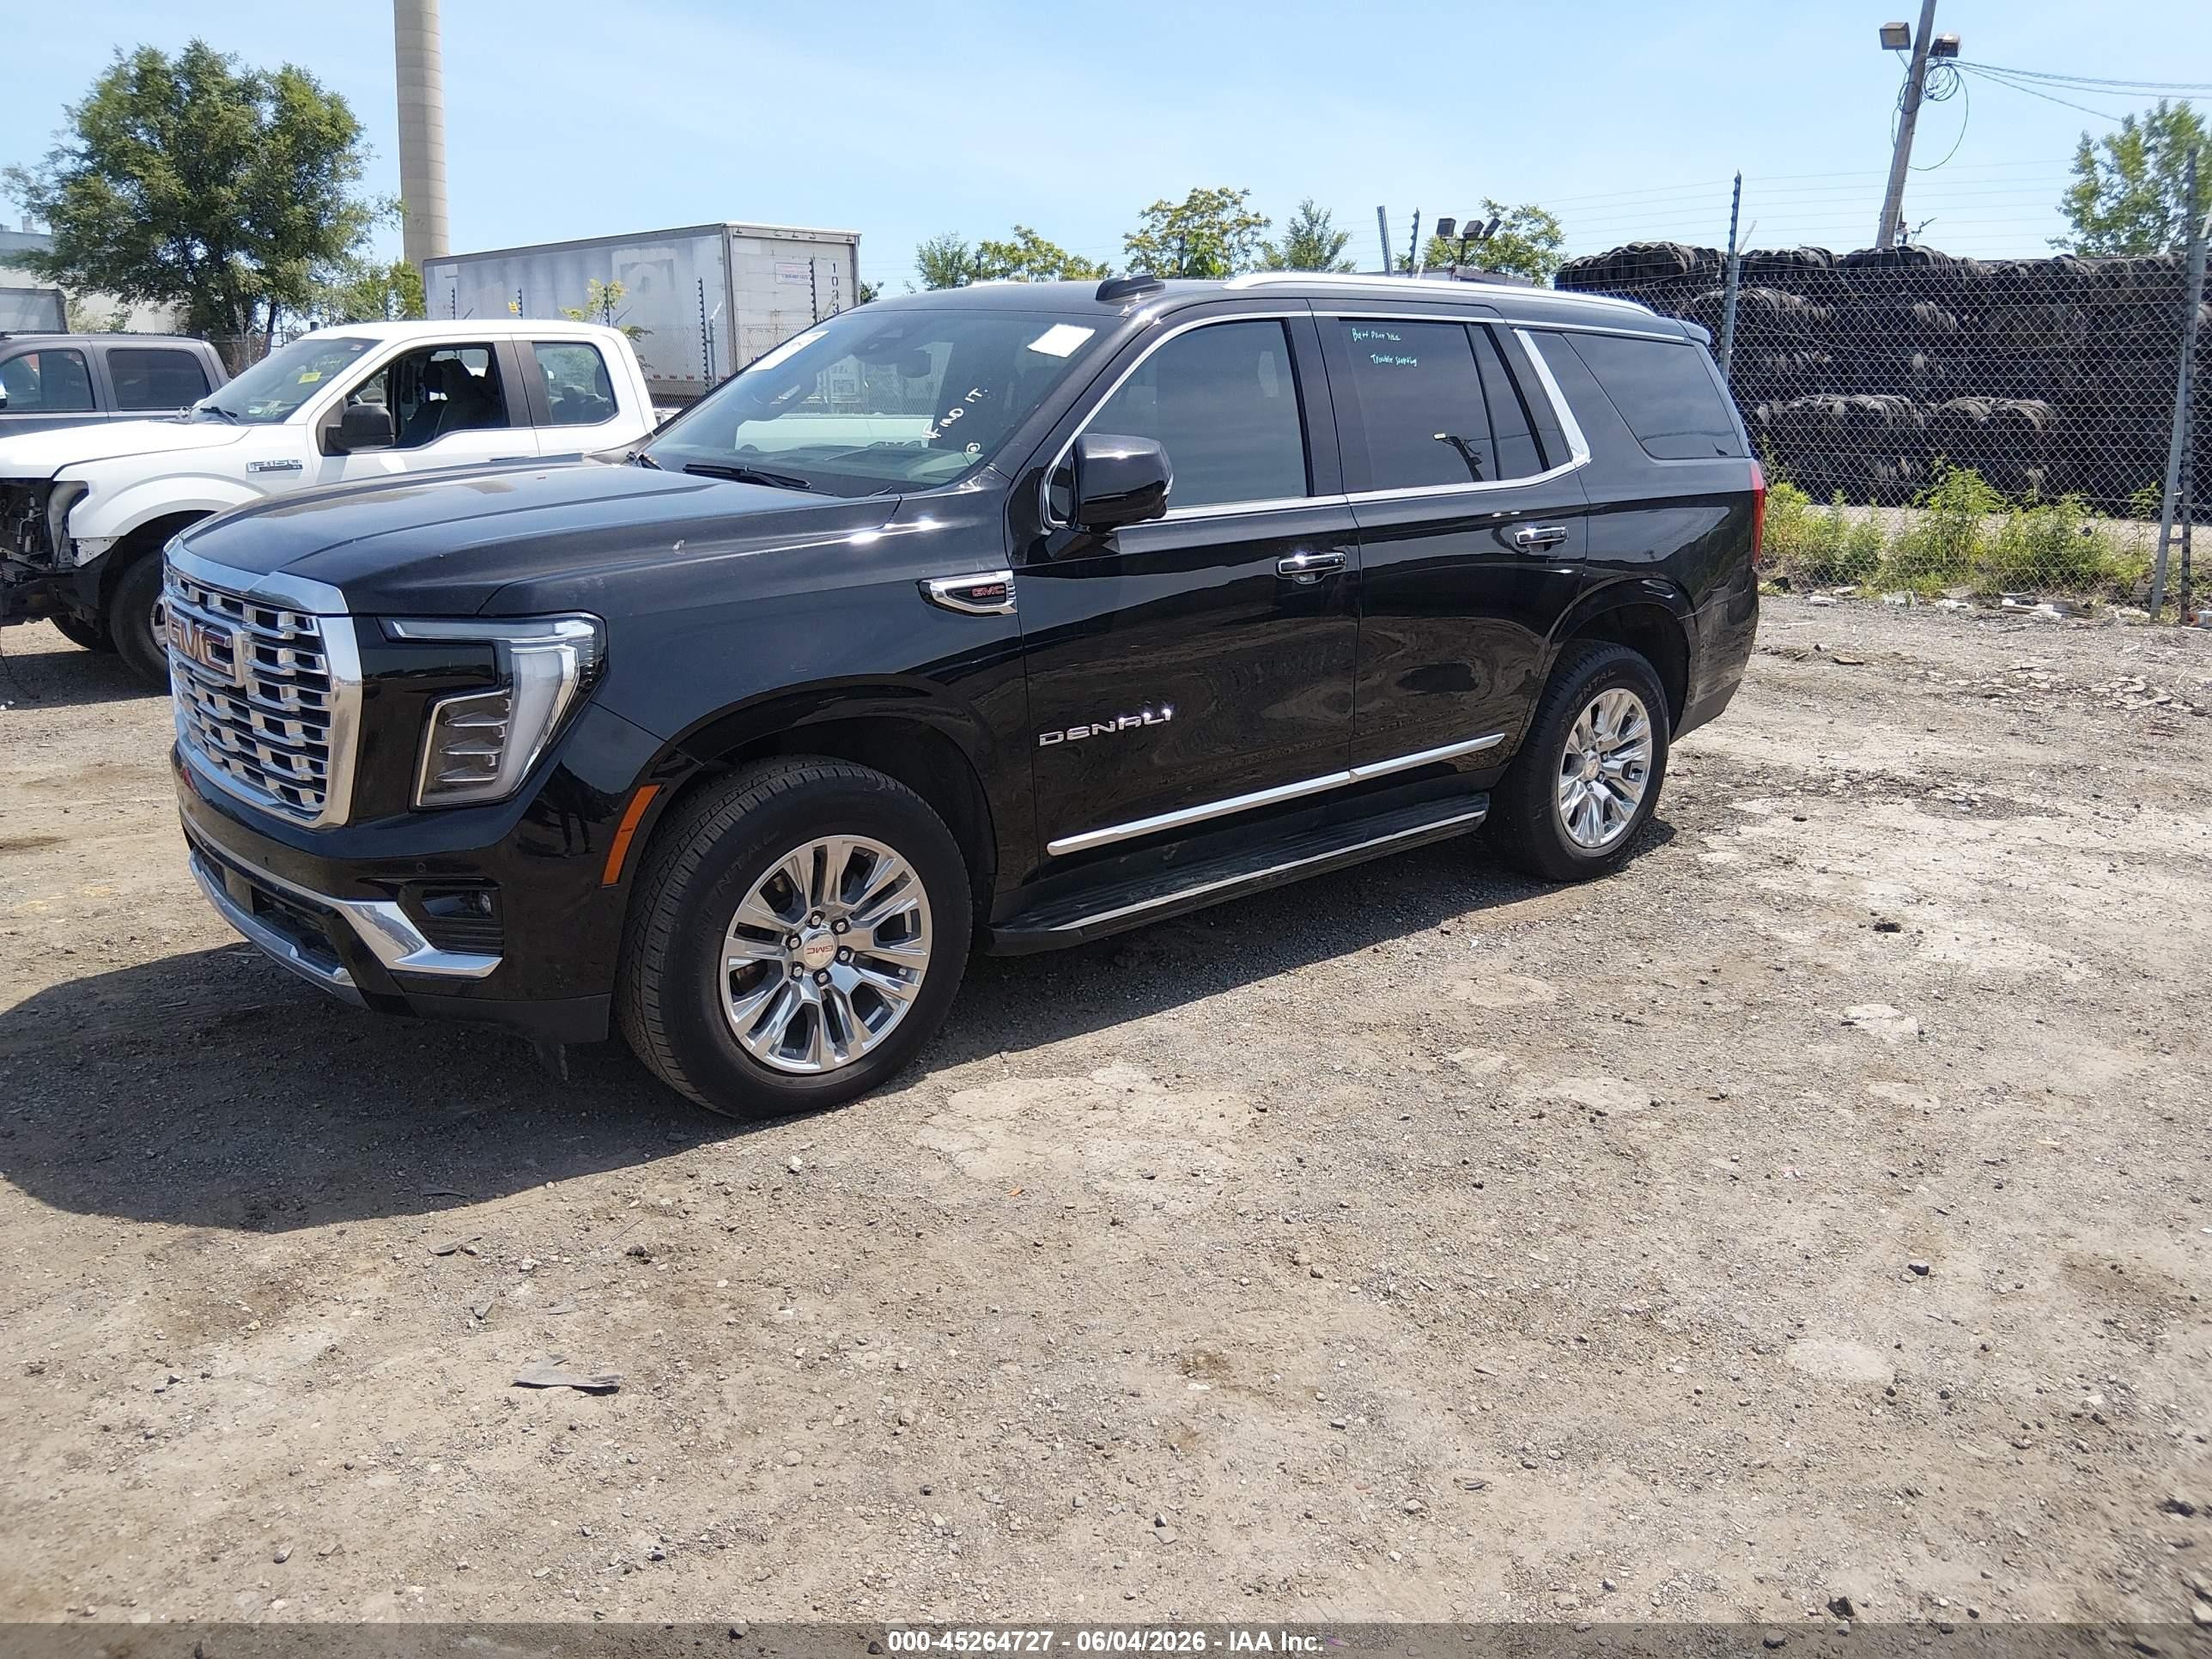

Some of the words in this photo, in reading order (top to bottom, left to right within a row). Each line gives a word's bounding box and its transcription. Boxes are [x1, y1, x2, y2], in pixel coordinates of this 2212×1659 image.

[972, 585, 1006, 598] GMC
[167, 617, 236, 677] GMC
[1039, 708, 1171, 747] DENALI
[806, 945, 834, 955] GMC
